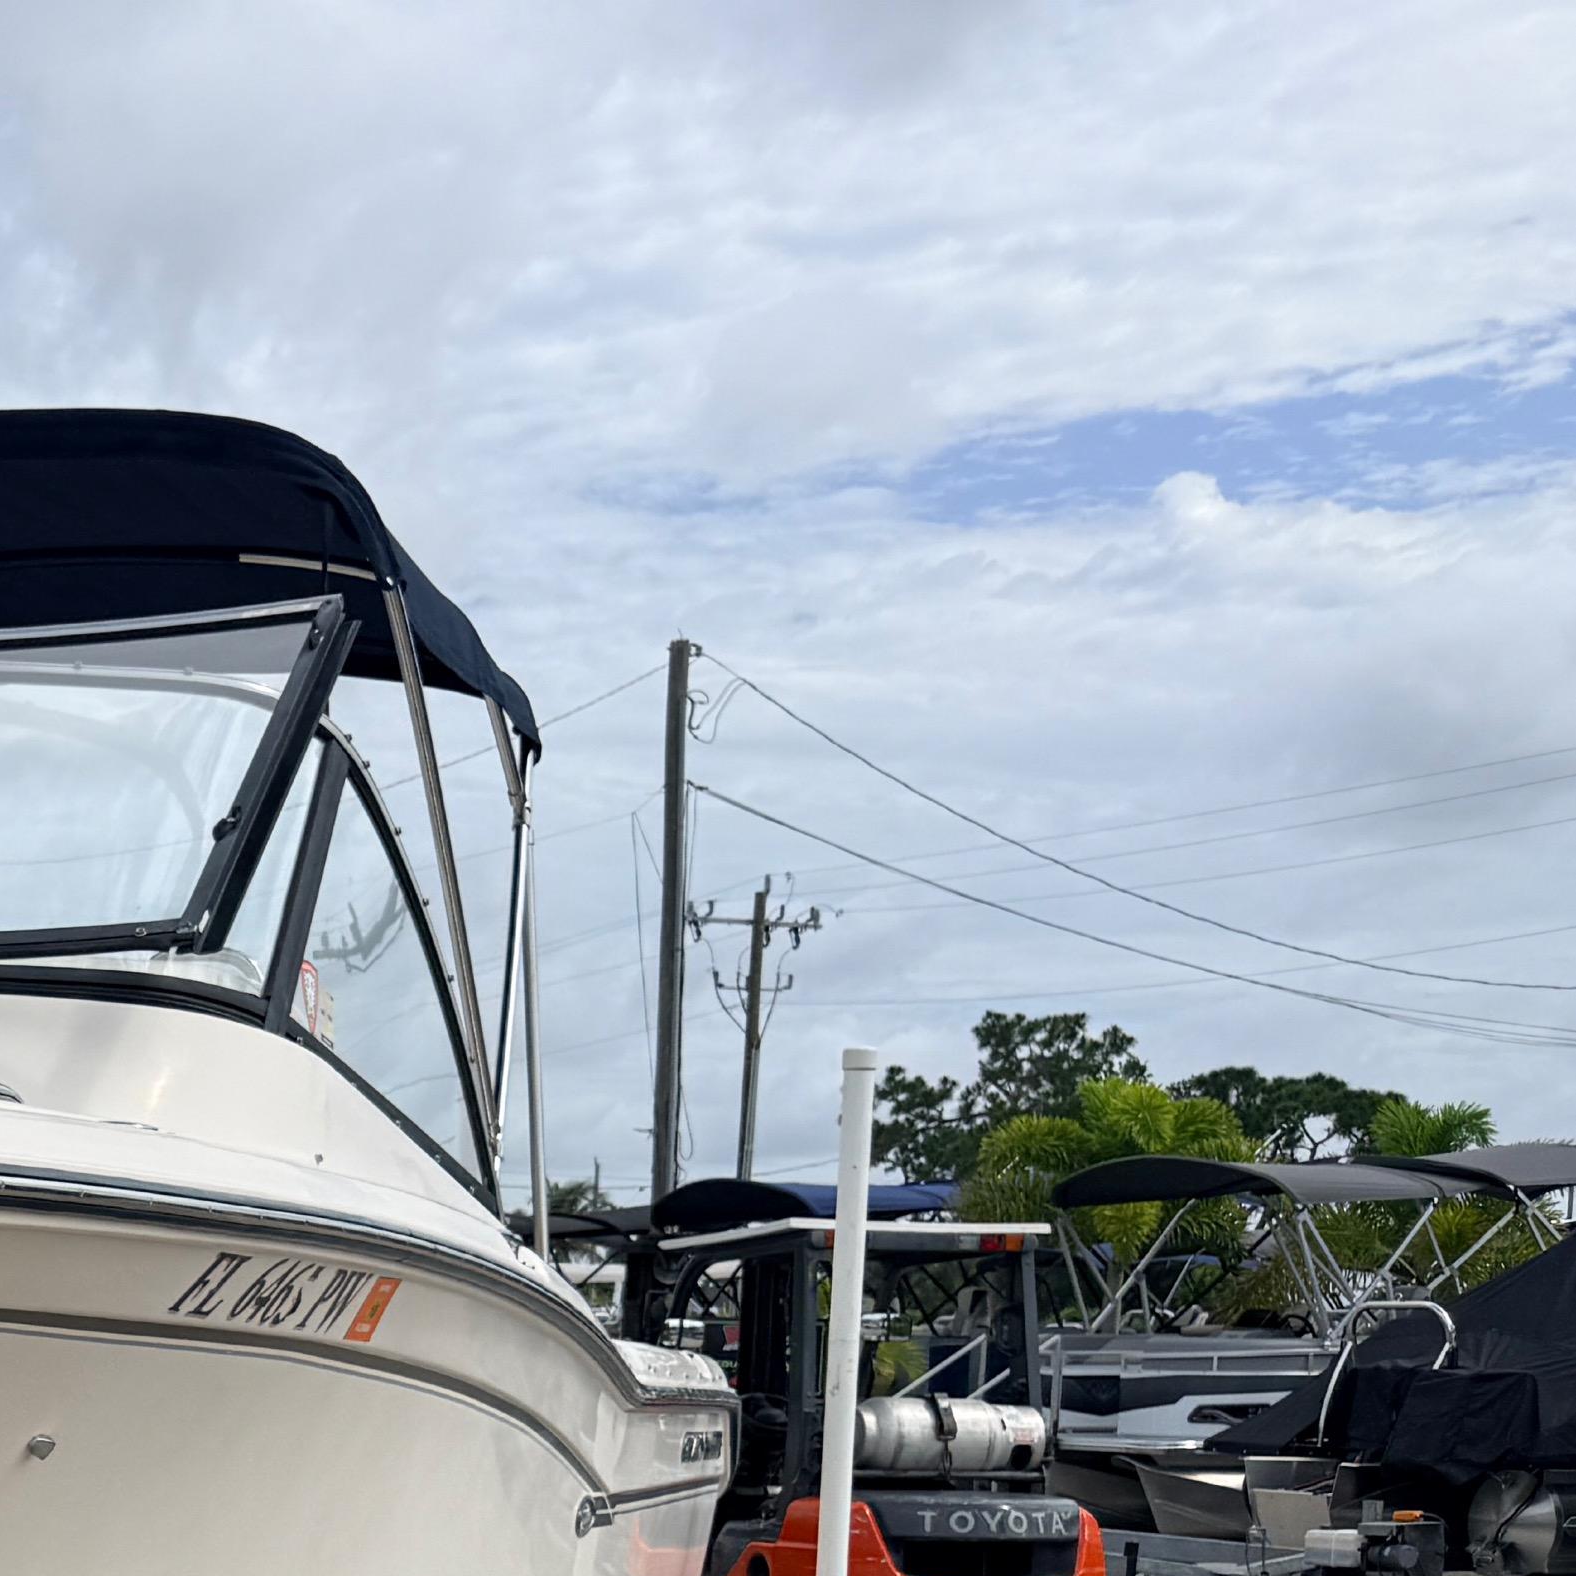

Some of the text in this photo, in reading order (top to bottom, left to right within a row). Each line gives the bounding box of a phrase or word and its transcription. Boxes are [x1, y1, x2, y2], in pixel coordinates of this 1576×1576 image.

[168, 1250, 374, 1334] FL 6465 PW
[917, 1509, 1069, 1536] TOYOTA
